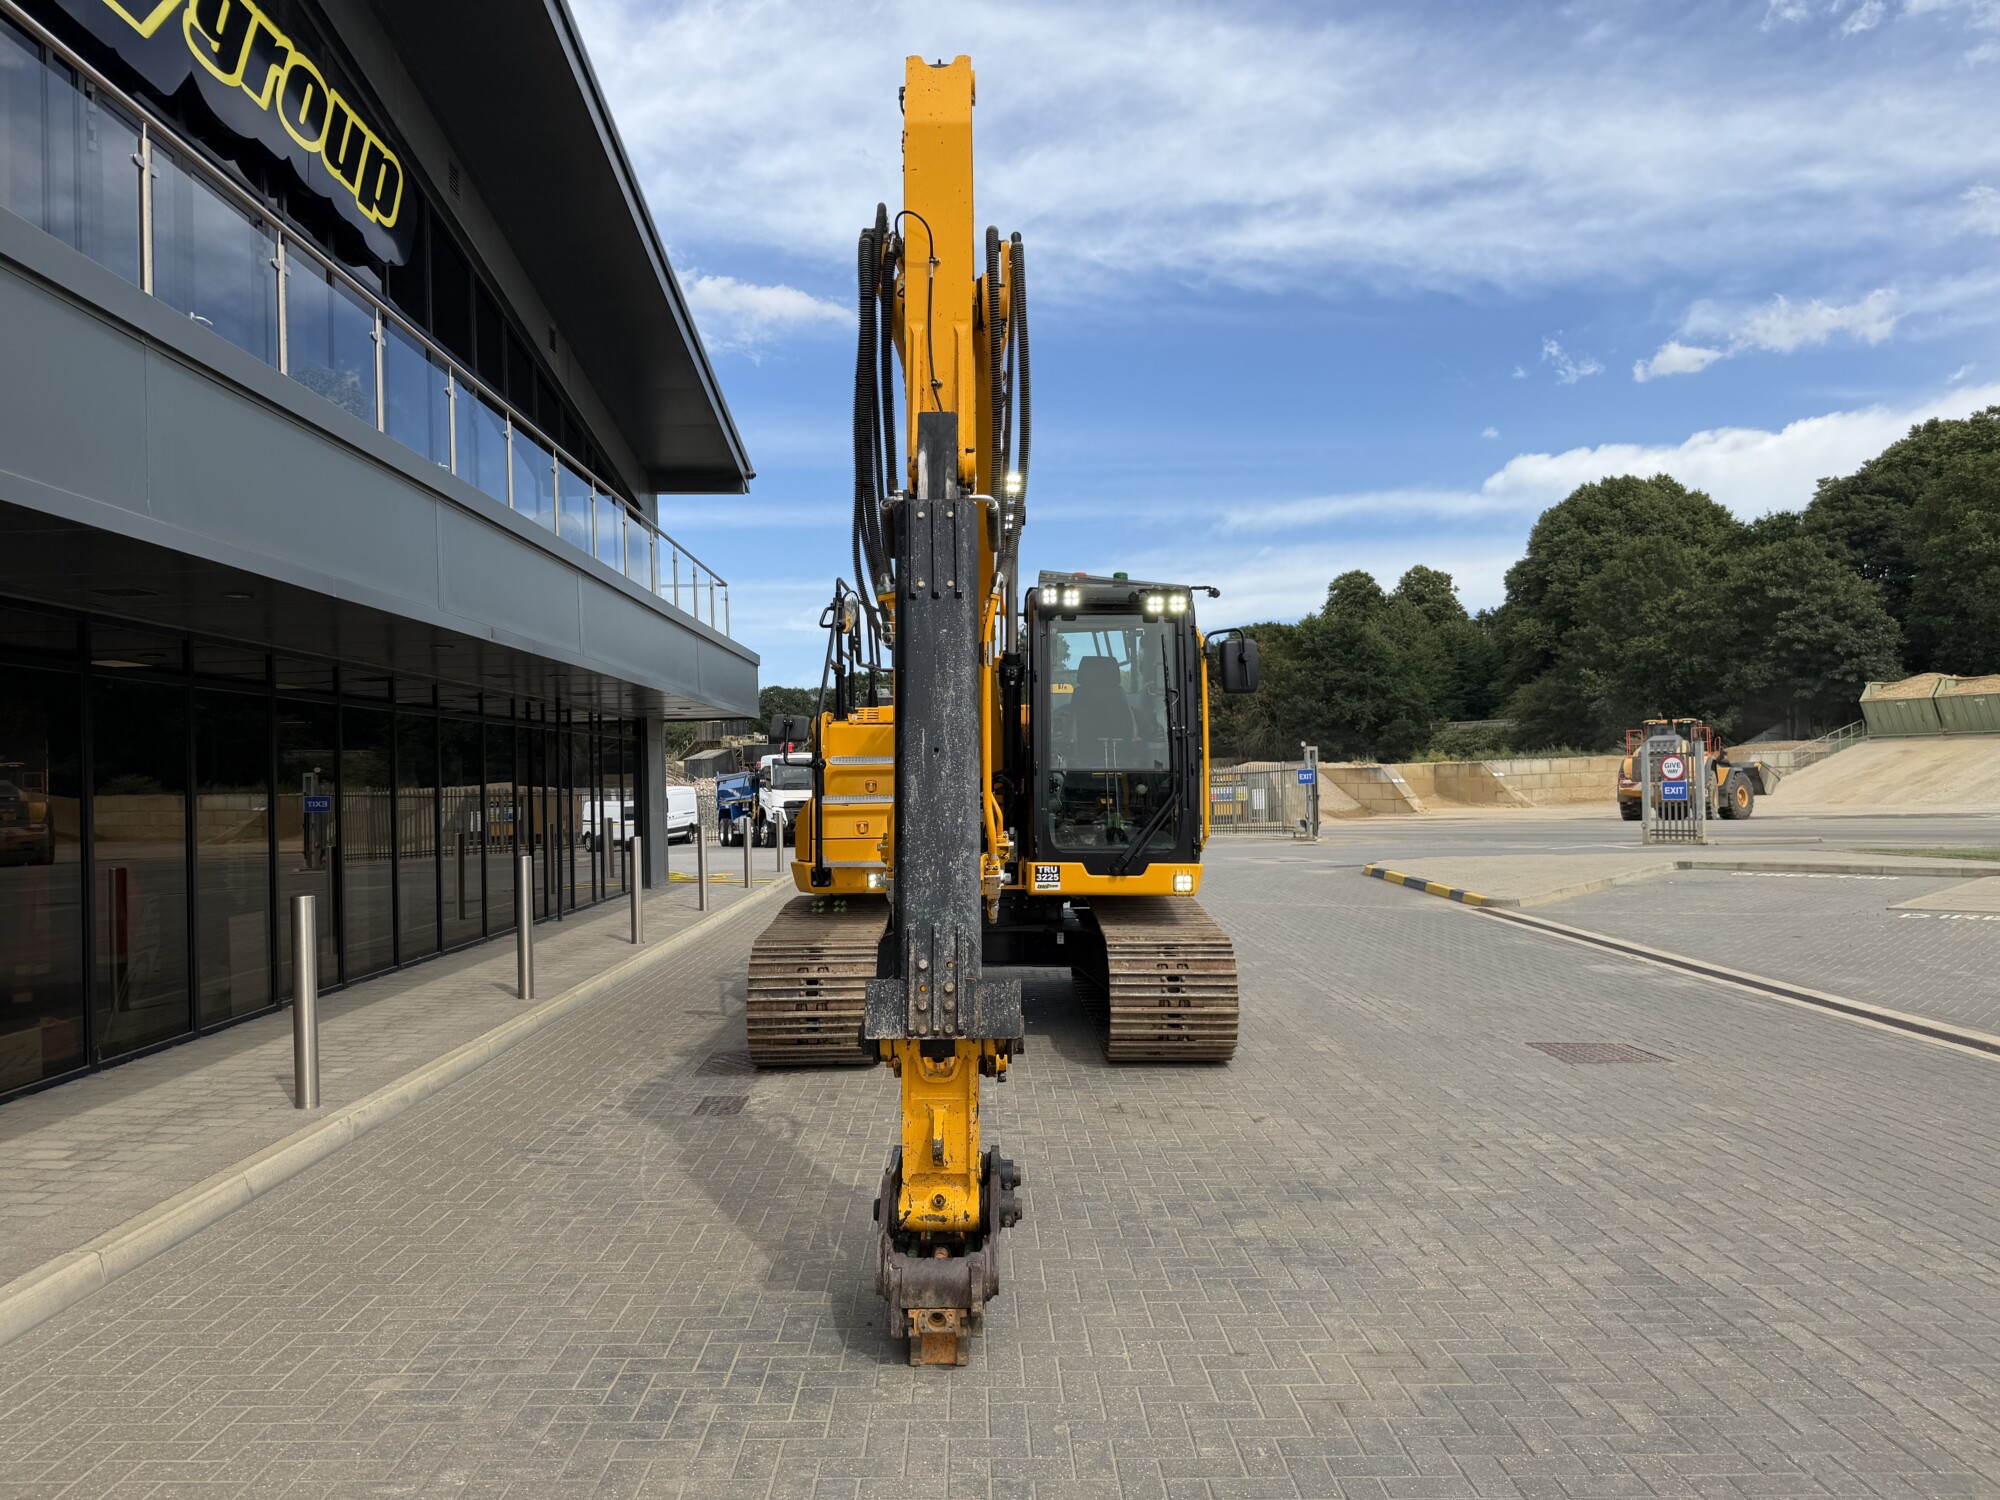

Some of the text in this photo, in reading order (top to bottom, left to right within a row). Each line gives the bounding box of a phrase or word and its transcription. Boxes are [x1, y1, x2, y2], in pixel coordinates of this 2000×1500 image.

[103, 0, 403, 228] group
[1664, 786, 1684, 795] EXIT
[1037, 865, 1058, 874] TRU
[1036, 873, 1059, 881] 3225
